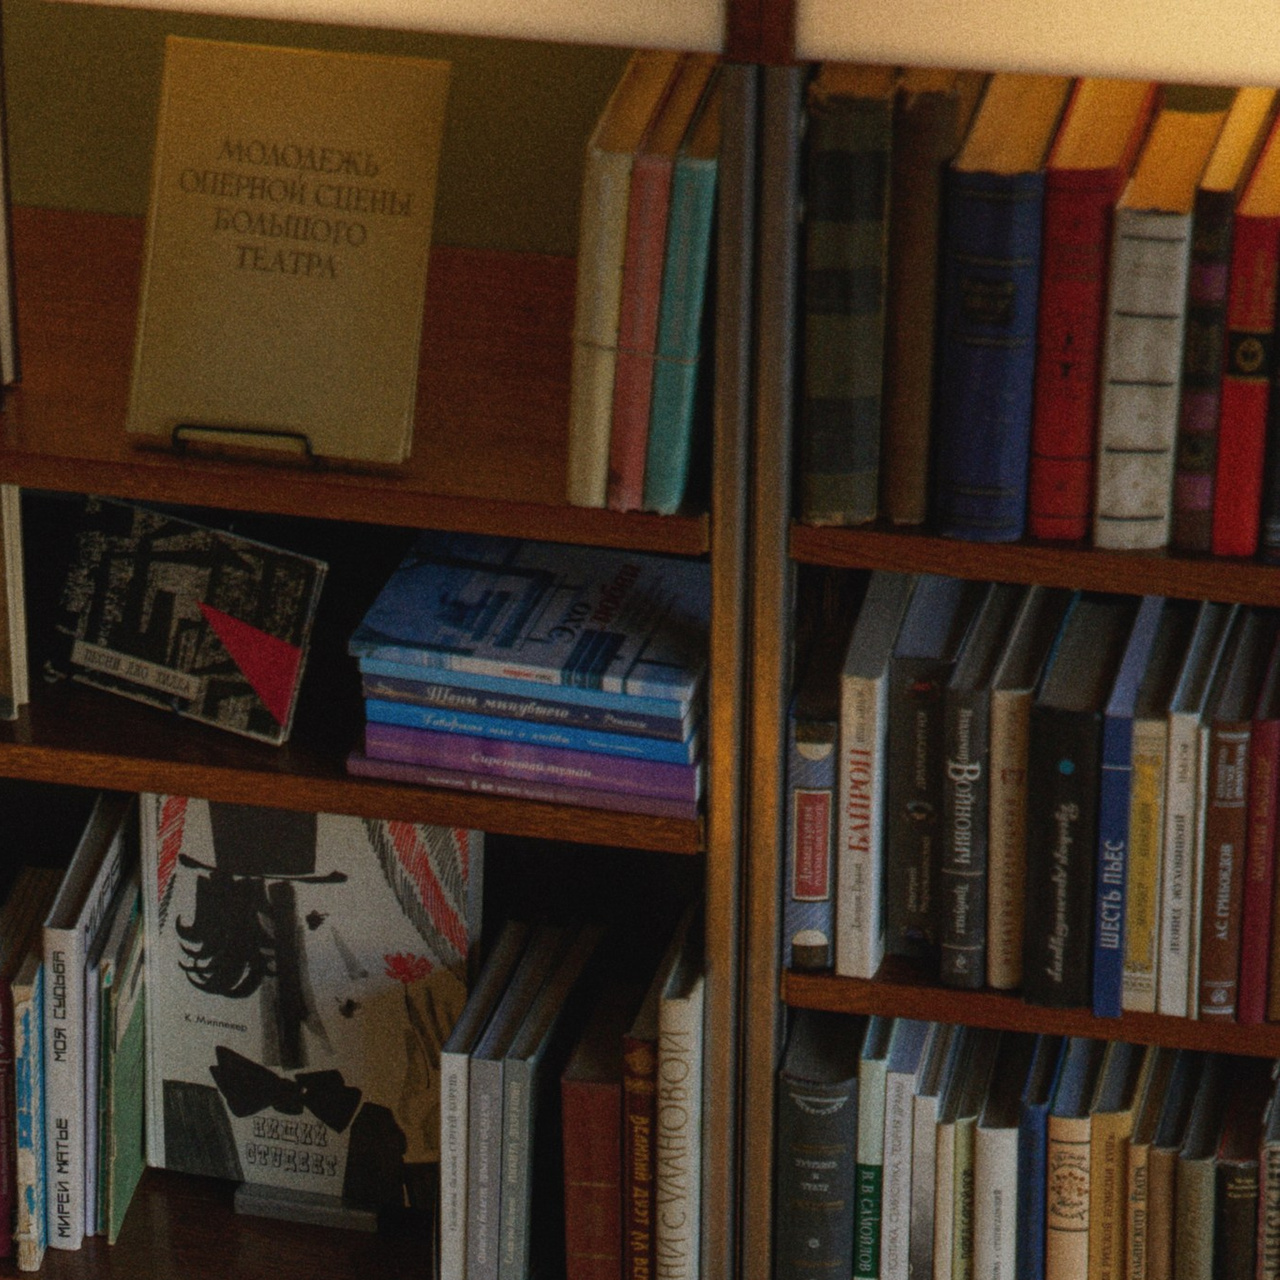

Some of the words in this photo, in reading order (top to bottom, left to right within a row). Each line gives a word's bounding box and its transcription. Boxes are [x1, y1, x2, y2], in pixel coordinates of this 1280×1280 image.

[217, 139, 380, 178] МОЛОДЕЖЬ
[178, 167, 306, 206] ОПЕРНОЙ
[313, 184, 413, 217] СЦЕНЫ
[214, 206, 367, 247] БОЛЬШОГО
[236, 244, 337, 279] ТЕАТРА
[579, 555, 650, 632] любви
[546, 595, 599, 650] Эхо
[843, 746, 873, 854] БАЙРОН
[945, 759, 981, 867] ВОЙНОВИЧ
[1101, 837, 1124, 885] ПЬЕС
[1215, 842, 1234, 916] ГРИБОЕДОВ
[1099, 888, 1122, 950] ШЕСТЬ
[50, 948, 67, 1019] СУДЬБА
[52, 1026, 67, 1062] МОЯ
[183, 1012, 195, 1024] К.
[194, 1015, 249, 1034] Миллекер
[447, 1072, 459, 1112] КОРЕНЬ
[659, 1028, 690, 1204] УЛАНОВОЙ
[54, 1116, 70, 1173] МАТЬЕ
[447, 1114, 459, 1152] СЕРГЕЙ
[626, 1113, 651, 1182] ВЕЛИКИЙ
[242, 1141, 340, 1178] СТУДЕНТ
[55, 1179, 71, 1238] МИРЕЙ
[630, 1186, 649, 1226] ДУЭТ
[1101, 1165, 1115, 1218] КОМЕДИИ
[660, 1208, 687, 1230] С
[857, 1197, 877, 1273] САМОЙЛОВ
[1099, 1221, 1113, 1268] РУССКОЙ
